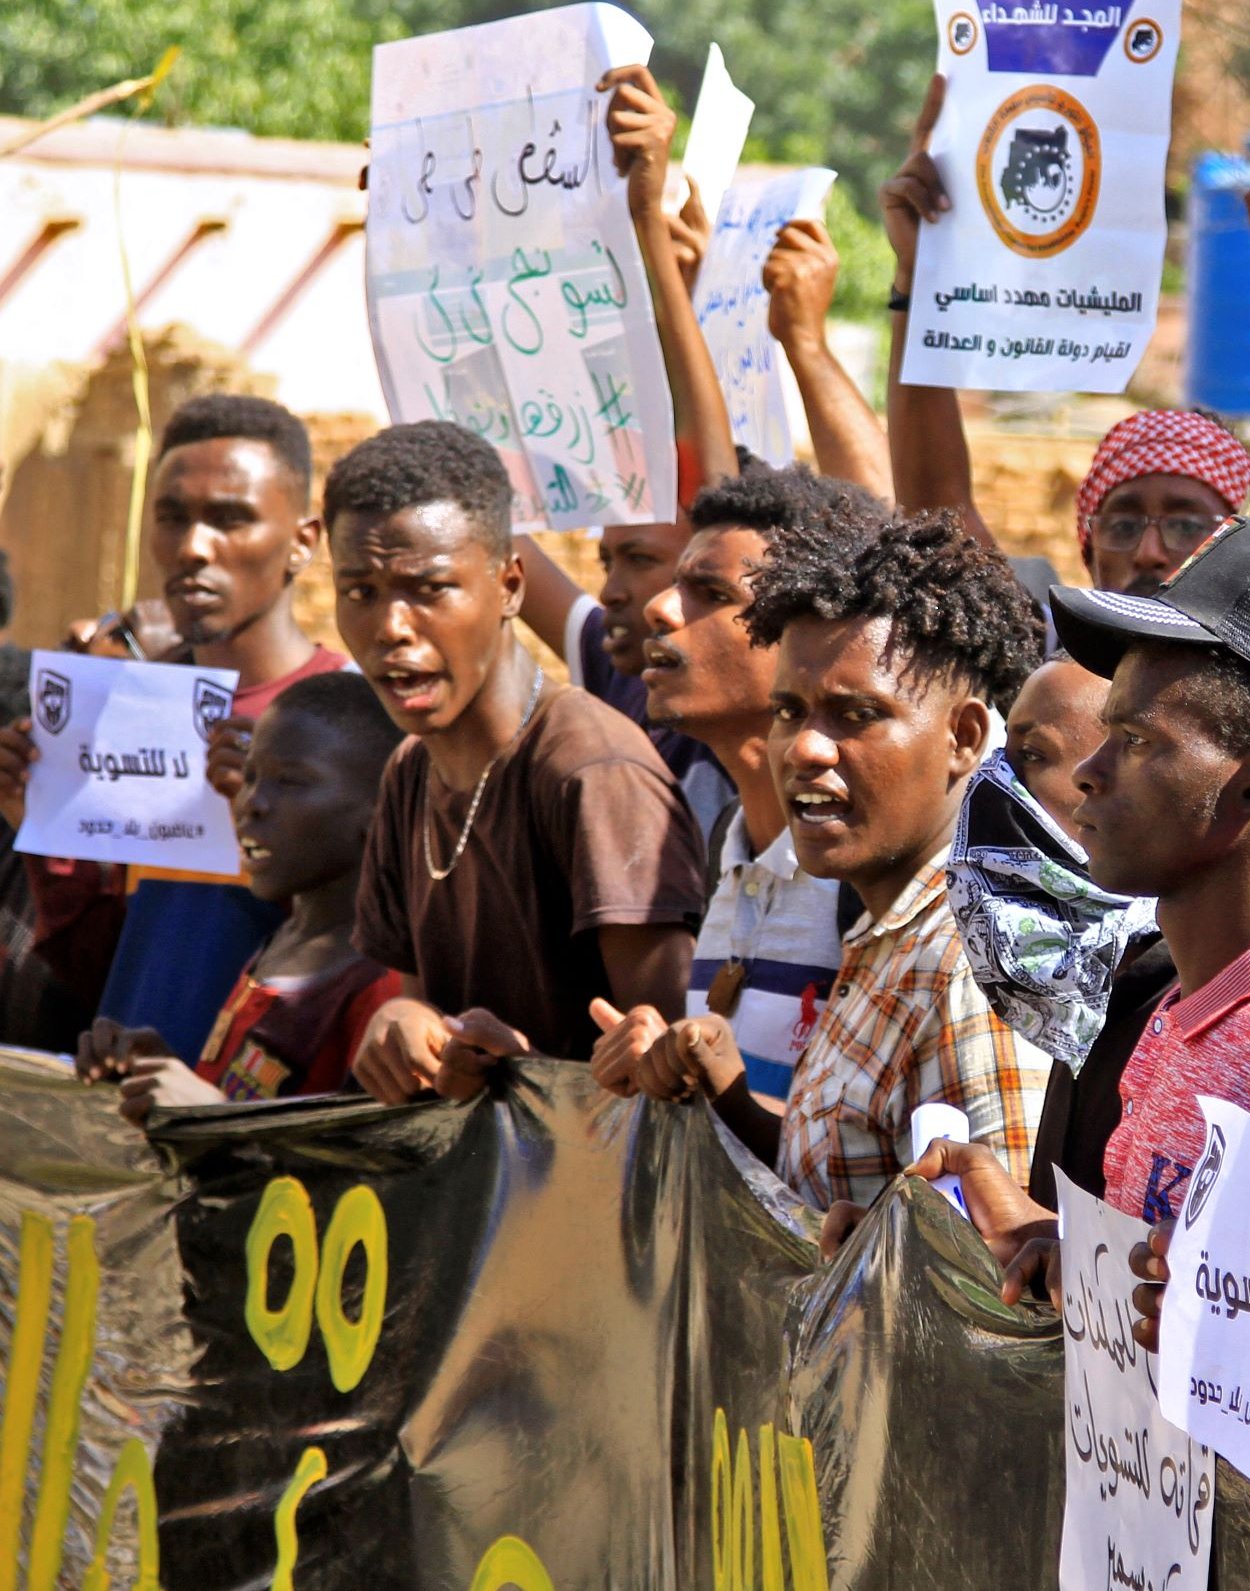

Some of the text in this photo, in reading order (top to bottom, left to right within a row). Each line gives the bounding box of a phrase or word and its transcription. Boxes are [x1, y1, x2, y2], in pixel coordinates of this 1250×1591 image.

[982, 1, 1122, 33] المجد للشهداء
[934, 282, 1143, 317] المليشيات مهدد اساسي
[922, 329, 1132, 364] لقيام دولة القانون و العدالة
[78, 745, 190, 782] لا للتسوية
